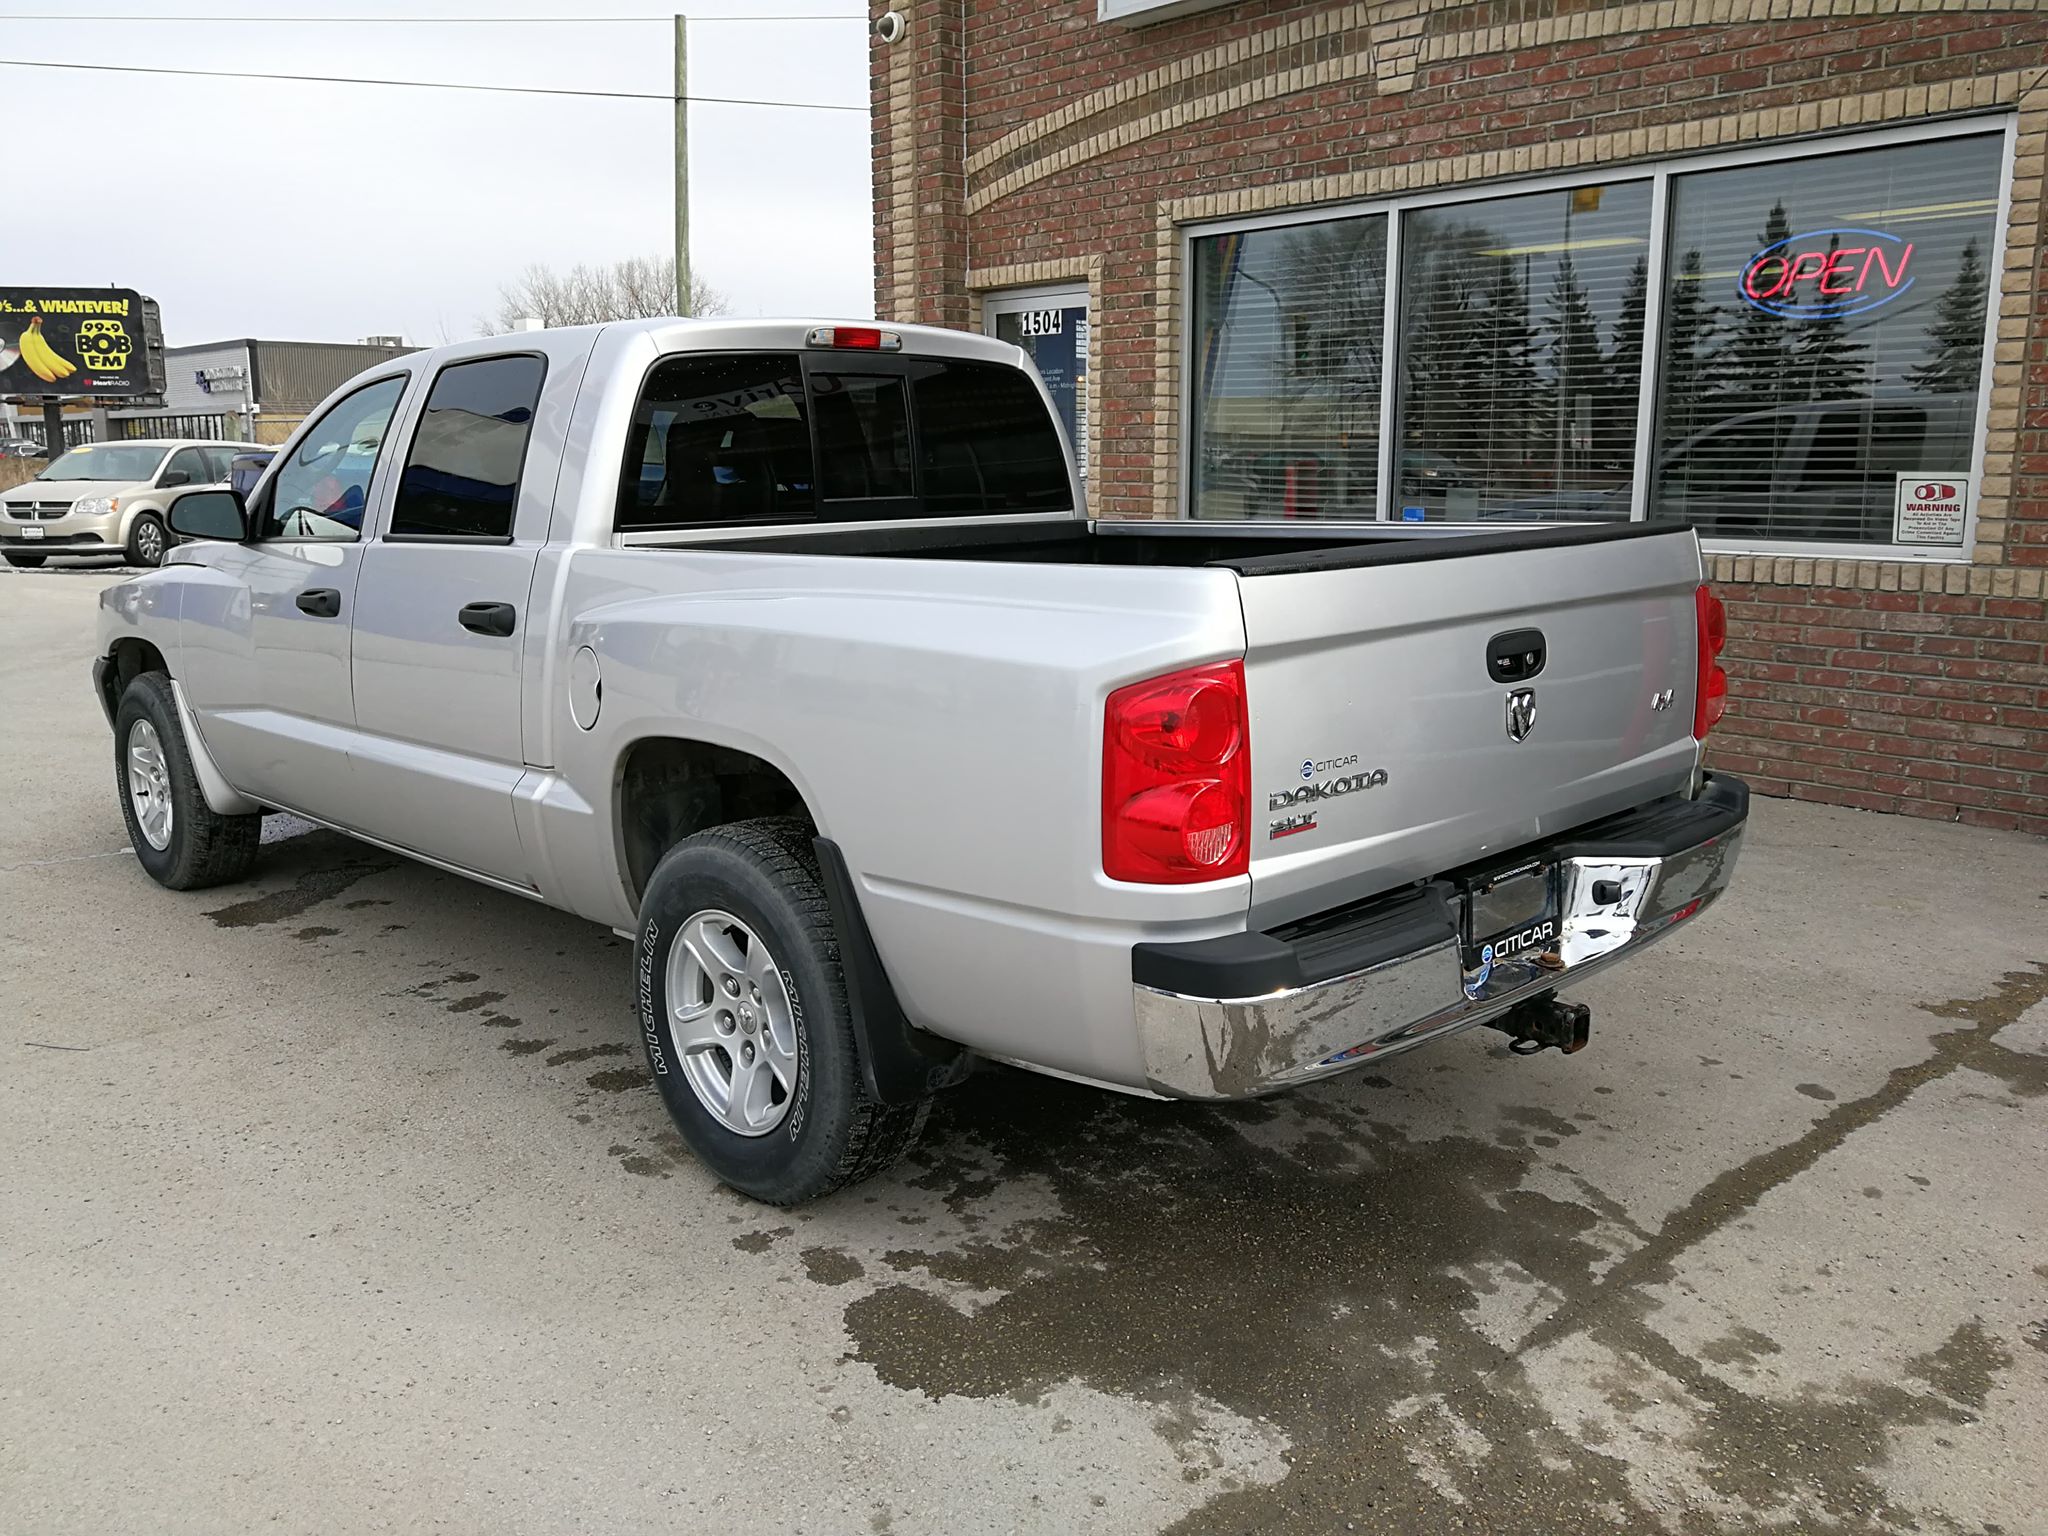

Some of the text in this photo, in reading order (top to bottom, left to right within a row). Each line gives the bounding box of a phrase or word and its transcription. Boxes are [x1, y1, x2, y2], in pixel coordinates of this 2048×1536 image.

[1745, 243, 1913, 299] OPEN
[39, 298, 129, 317] WHATEVER!
[1023, 309, 1061, 334] 1504
[76, 333, 133, 354] BOB
[88, 355, 123, 368] FM
[1906, 503, 1961, 512] WARNING
[1315, 754, 1358, 772] CITICAR
[1269, 768, 1389, 811] DAKOTA
[1269, 810, 1318, 833] SLT
[1494, 921, 1553, 958] CITICAR
[638, 917, 668, 1075] MICHELIN
[782, 970, 811, 1142] MICHELIN
